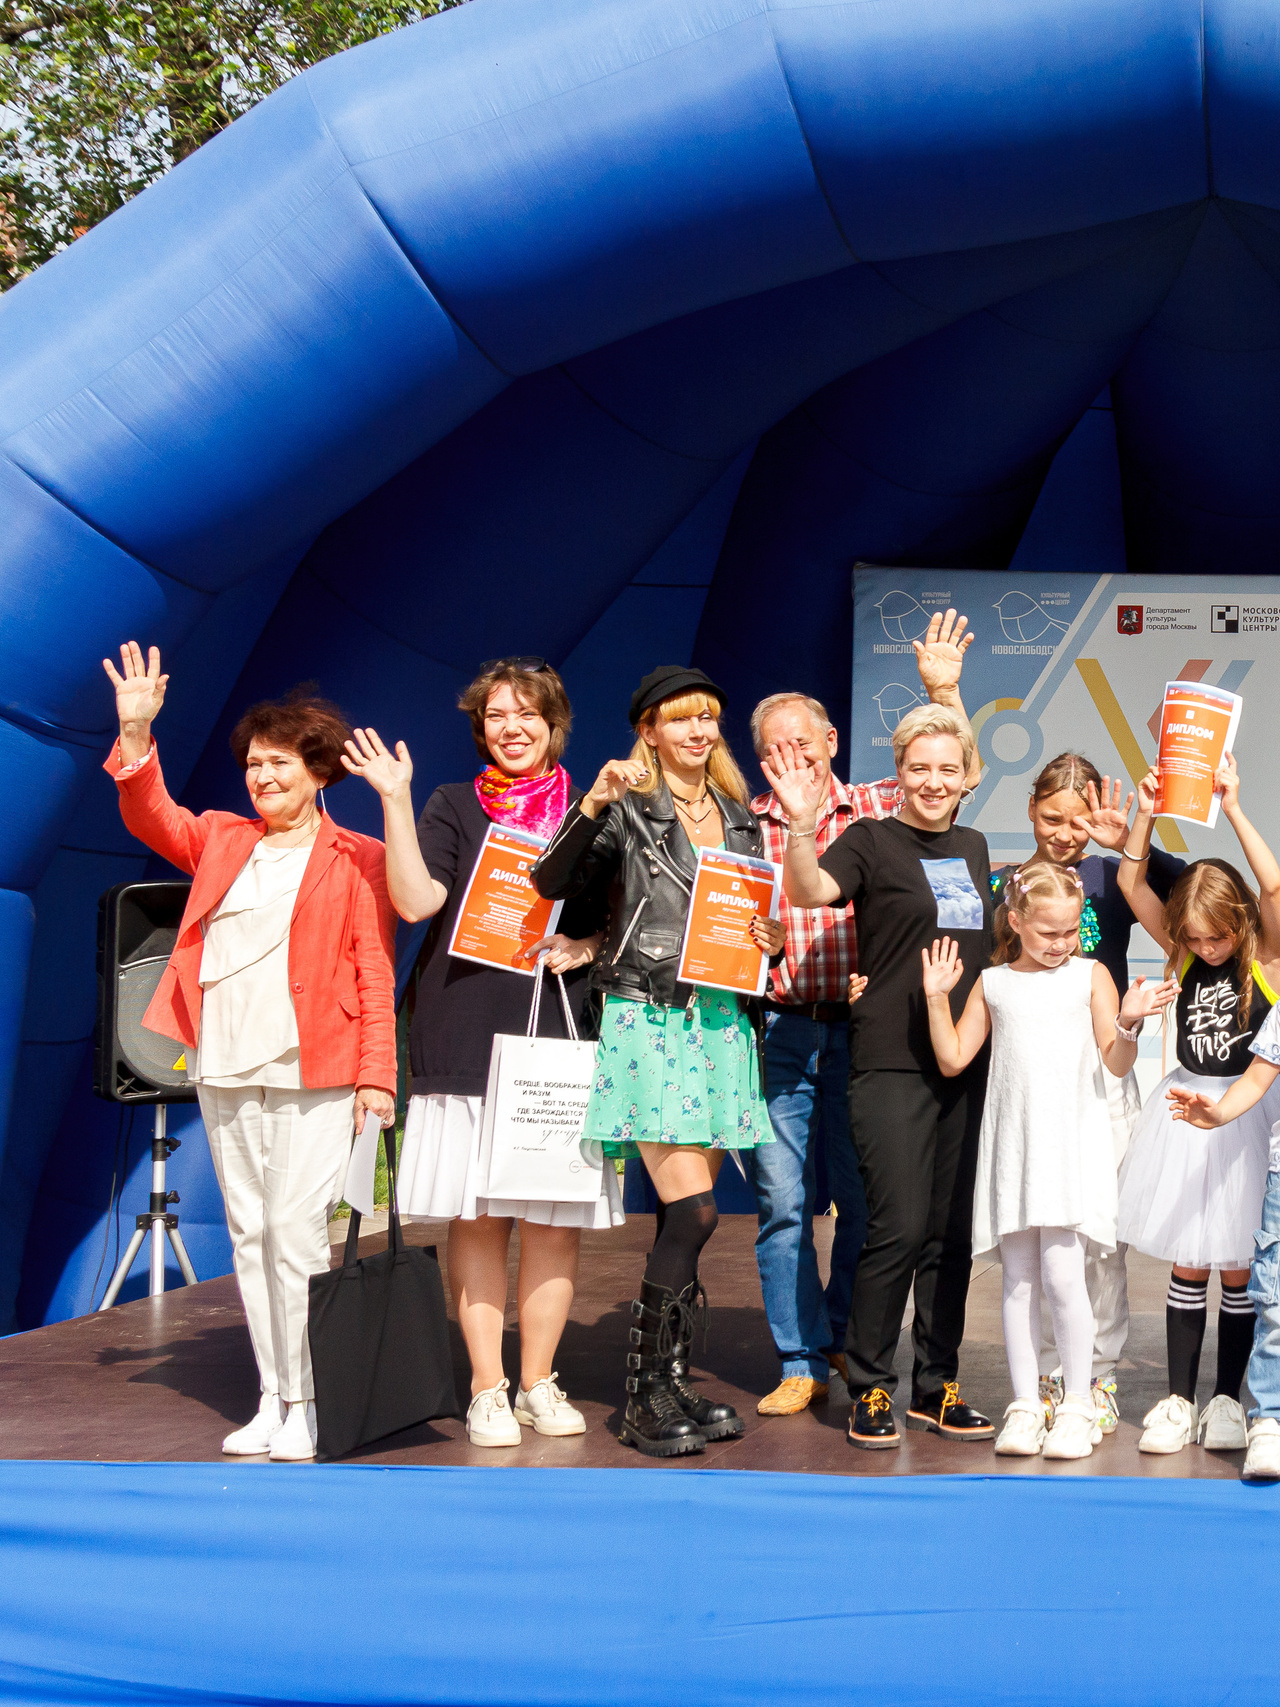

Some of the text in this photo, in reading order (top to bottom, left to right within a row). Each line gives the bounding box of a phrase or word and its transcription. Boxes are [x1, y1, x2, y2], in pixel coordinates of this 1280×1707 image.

[873, 644, 917, 654] НОВОСЛОБ
[1167, 723, 1214, 740] ДИПЛОМ
[489, 868, 533, 888] ДИПЛО
[707, 891, 759, 910] ДИПЛОМ
[544, 1081, 591, 1090] ВООБРАЖЕНИ
[532, 1108, 583, 1117] ЗАРОЖДАЕТСЯ
[540, 1118, 580, 1126] НАЗЫВАЕМ
